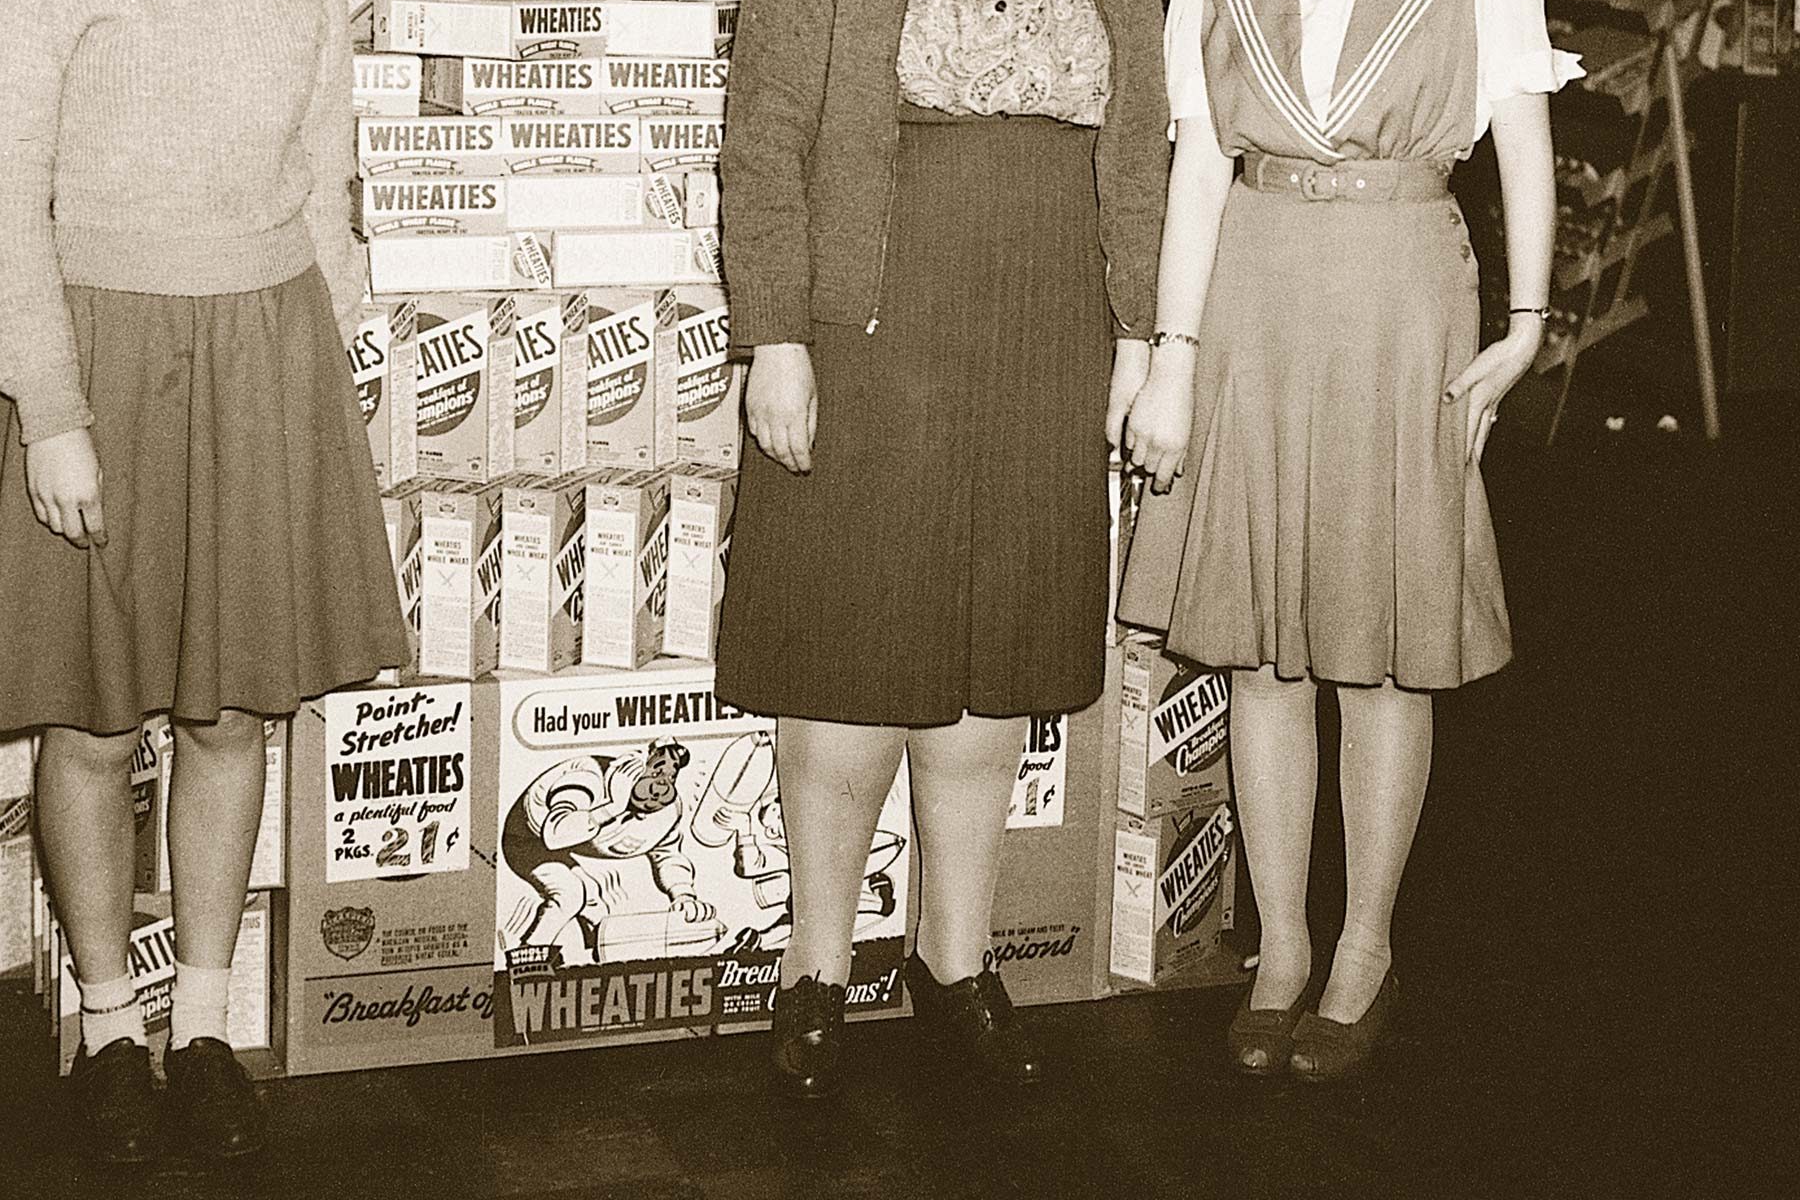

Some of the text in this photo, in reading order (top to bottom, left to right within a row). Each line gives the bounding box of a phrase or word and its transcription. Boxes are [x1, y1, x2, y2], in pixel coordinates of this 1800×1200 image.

[519, 6, 602, 34] WHEATIES
[472, 62, 727, 90] WHEATIES WHEATIES
[368, 125, 493, 151] WHEATIES
[510, 123, 632, 148] WHEATIES
[372, 184, 497, 211] WHEATIES
[654, 176, 682, 226] WHEATIES
[522, 235, 550, 285] WHEATIES
[417, 324, 484, 380] ATIES
[356, 691, 435, 726] Point-
[534, 705, 612, 736] Had your
[340, 702, 463, 757] Stretcher!
[331, 753, 464, 802] WHEATIES
[1018, 757, 1055, 781] food
[334, 798, 458, 825] a plentiful food
[341, 828, 356, 845] 2
[334, 844, 374, 862] PKGS.
[1160, 814, 1225, 909] WHEATIES
[510, 967, 714, 1034] WHEATIES
